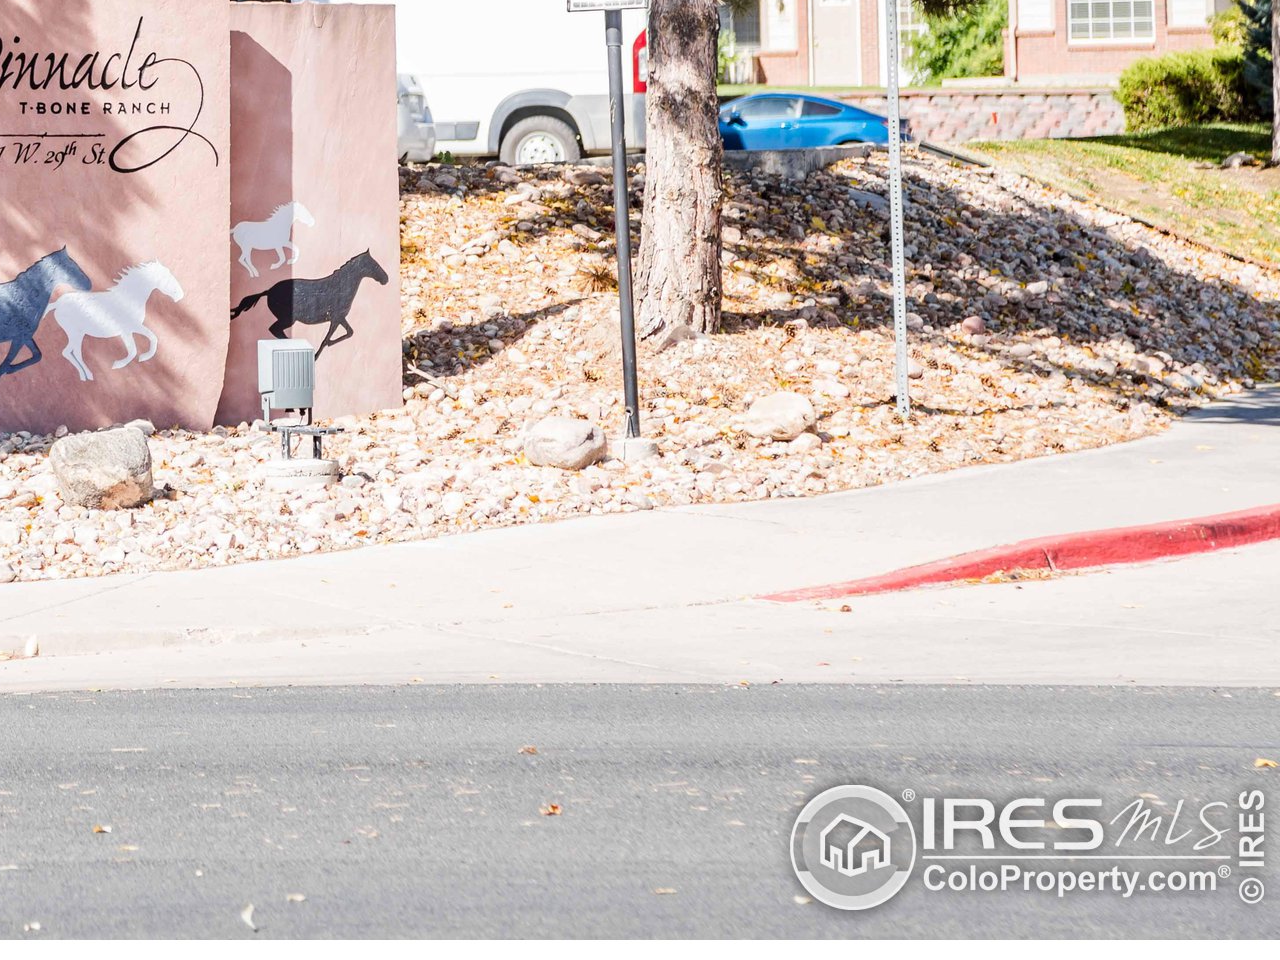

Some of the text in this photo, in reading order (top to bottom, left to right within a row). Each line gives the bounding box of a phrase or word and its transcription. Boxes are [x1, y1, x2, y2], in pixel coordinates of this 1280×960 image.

[103, 101, 171, 115] RANCH
[12, 142, 39, 165] W.
[43, 140, 77, 171] 29th
[81, 142, 107, 165] St.
